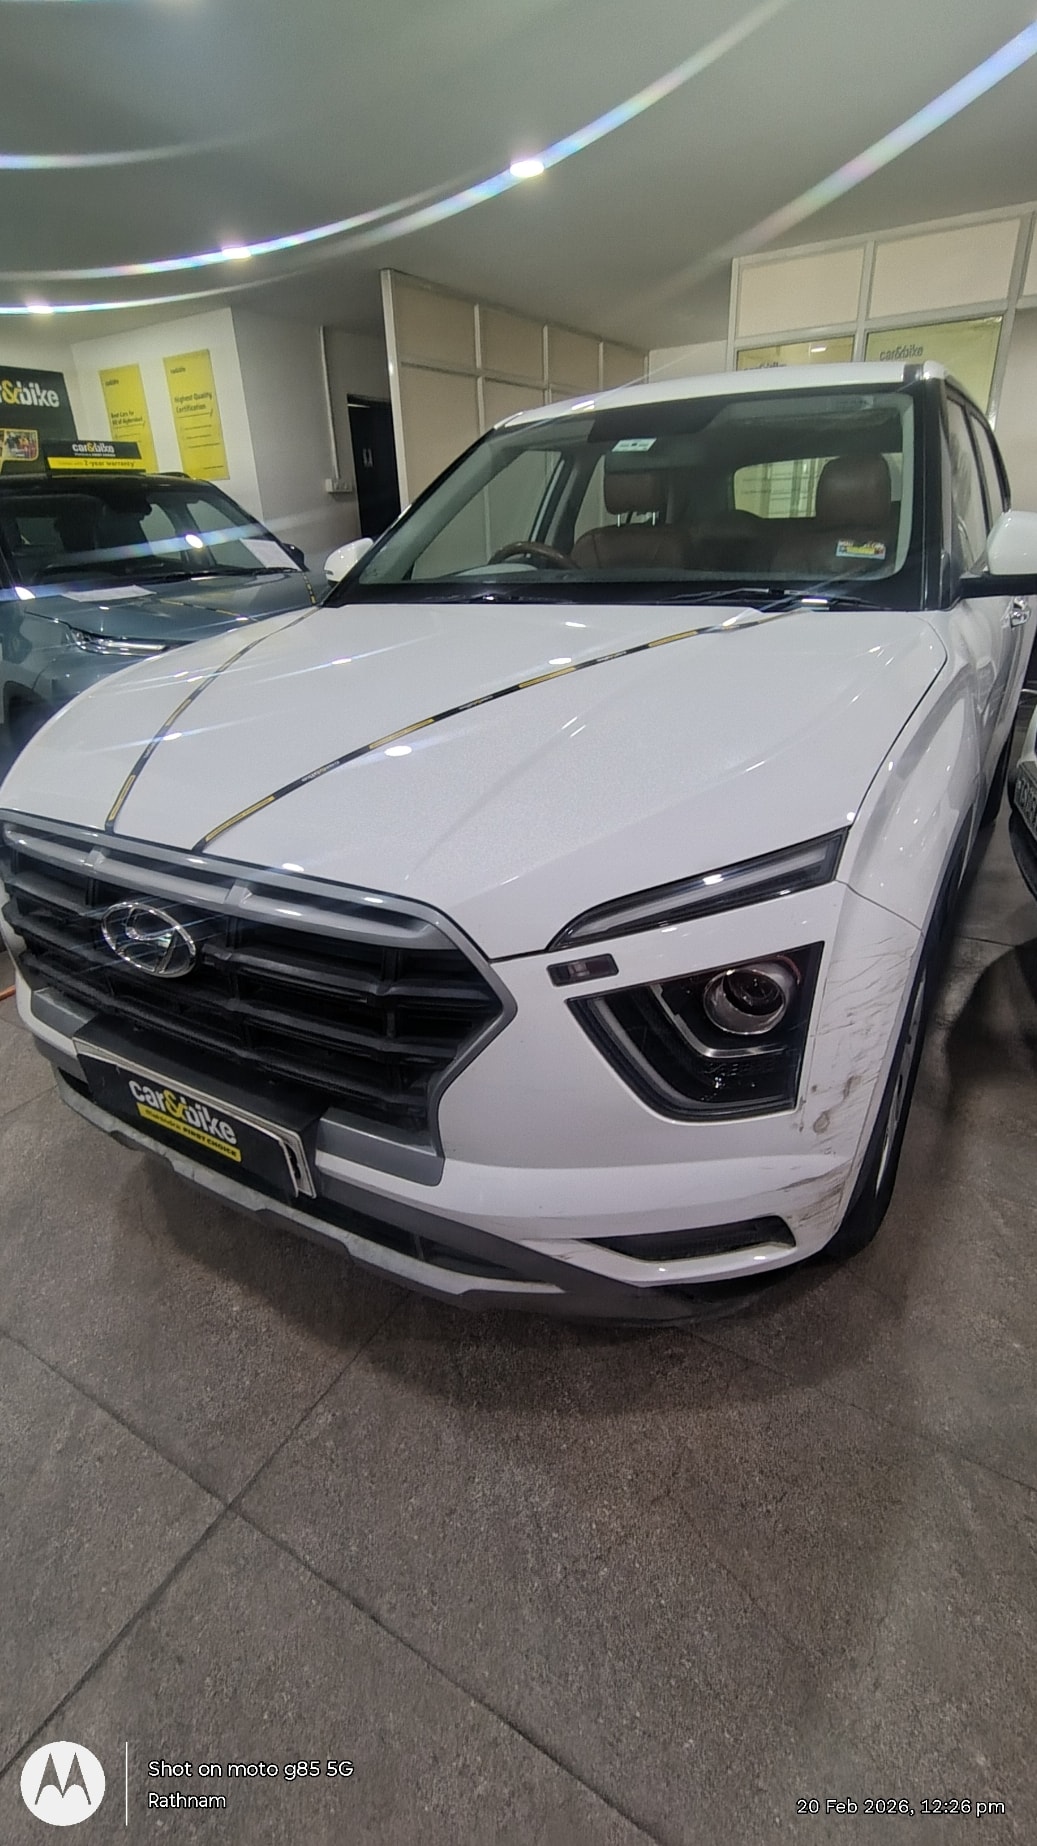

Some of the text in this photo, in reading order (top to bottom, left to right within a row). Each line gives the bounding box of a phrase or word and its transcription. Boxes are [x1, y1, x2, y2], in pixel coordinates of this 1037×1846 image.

[0, 380, 60, 407] &bike
[193, 392, 212, 400] Quality
[129, 1080, 237, 1144] car&bike
